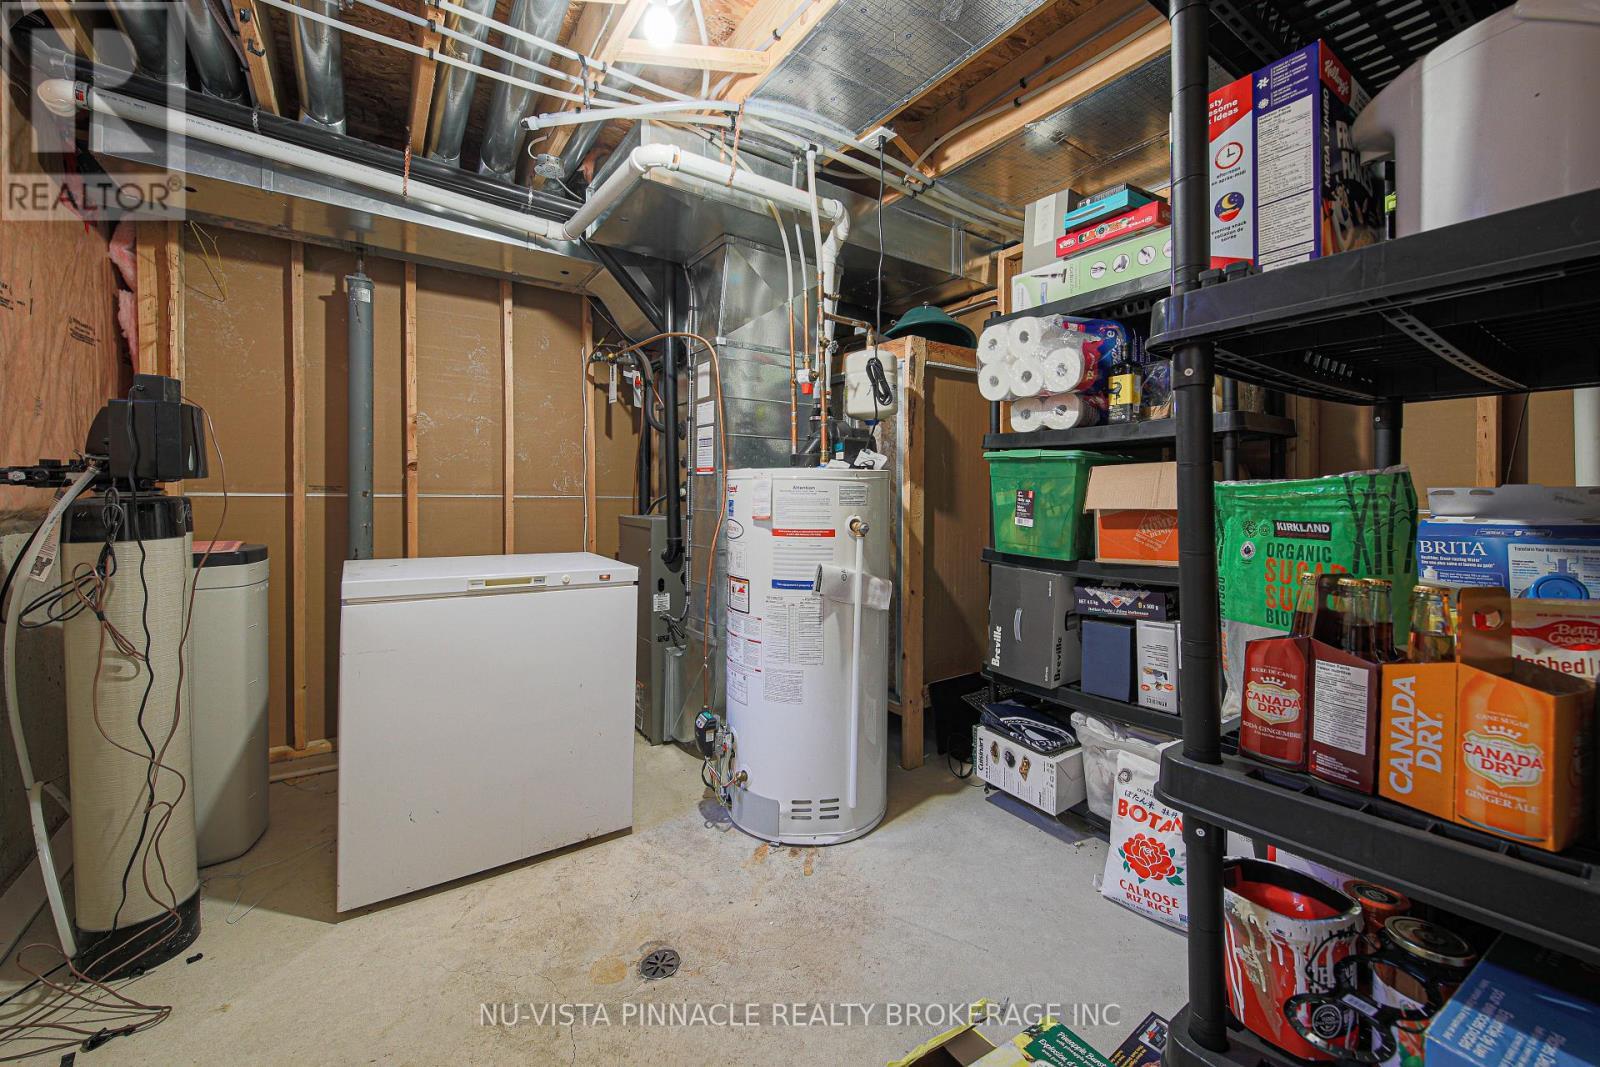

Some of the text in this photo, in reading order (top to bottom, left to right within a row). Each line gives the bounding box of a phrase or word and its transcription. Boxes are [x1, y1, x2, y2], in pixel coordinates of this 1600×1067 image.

[1209, 98, 1223, 109] sty
[1209, 99, 1238, 117] esome
[1276, 522, 1330, 534] KIRKLAND
[1266, 542, 1332, 564] ORGANIC
[1420, 540, 1488, 556] BRITA
[1553, 624, 1599, 640] Betty
[991, 625, 1002, 667] Breville
[1054, 637, 1062, 681] Breville
[1246, 690, 1301, 709] CANADA
[1258, 702, 1285, 716] DRY
[1389, 676, 1416, 794] CANADA
[1416, 708, 1443, 773] DRY
[1463, 742, 1544, 770] CANADA
[1481, 758, 1521, 777] DRY
[1465, 788, 1537, 814] GINGER ALE
[1117, 798, 1185, 834] BOTAN
[1119, 879, 1180, 909] CALROSE
[1126, 892, 1143, 905] RIZ
[1146, 900, 1173, 916] RICE
[1039, 1039, 1067, 1062] Explosion
[1057, 1031, 1088, 1056] Pineapple
[1085, 1051, 1108, 1067] Burst
